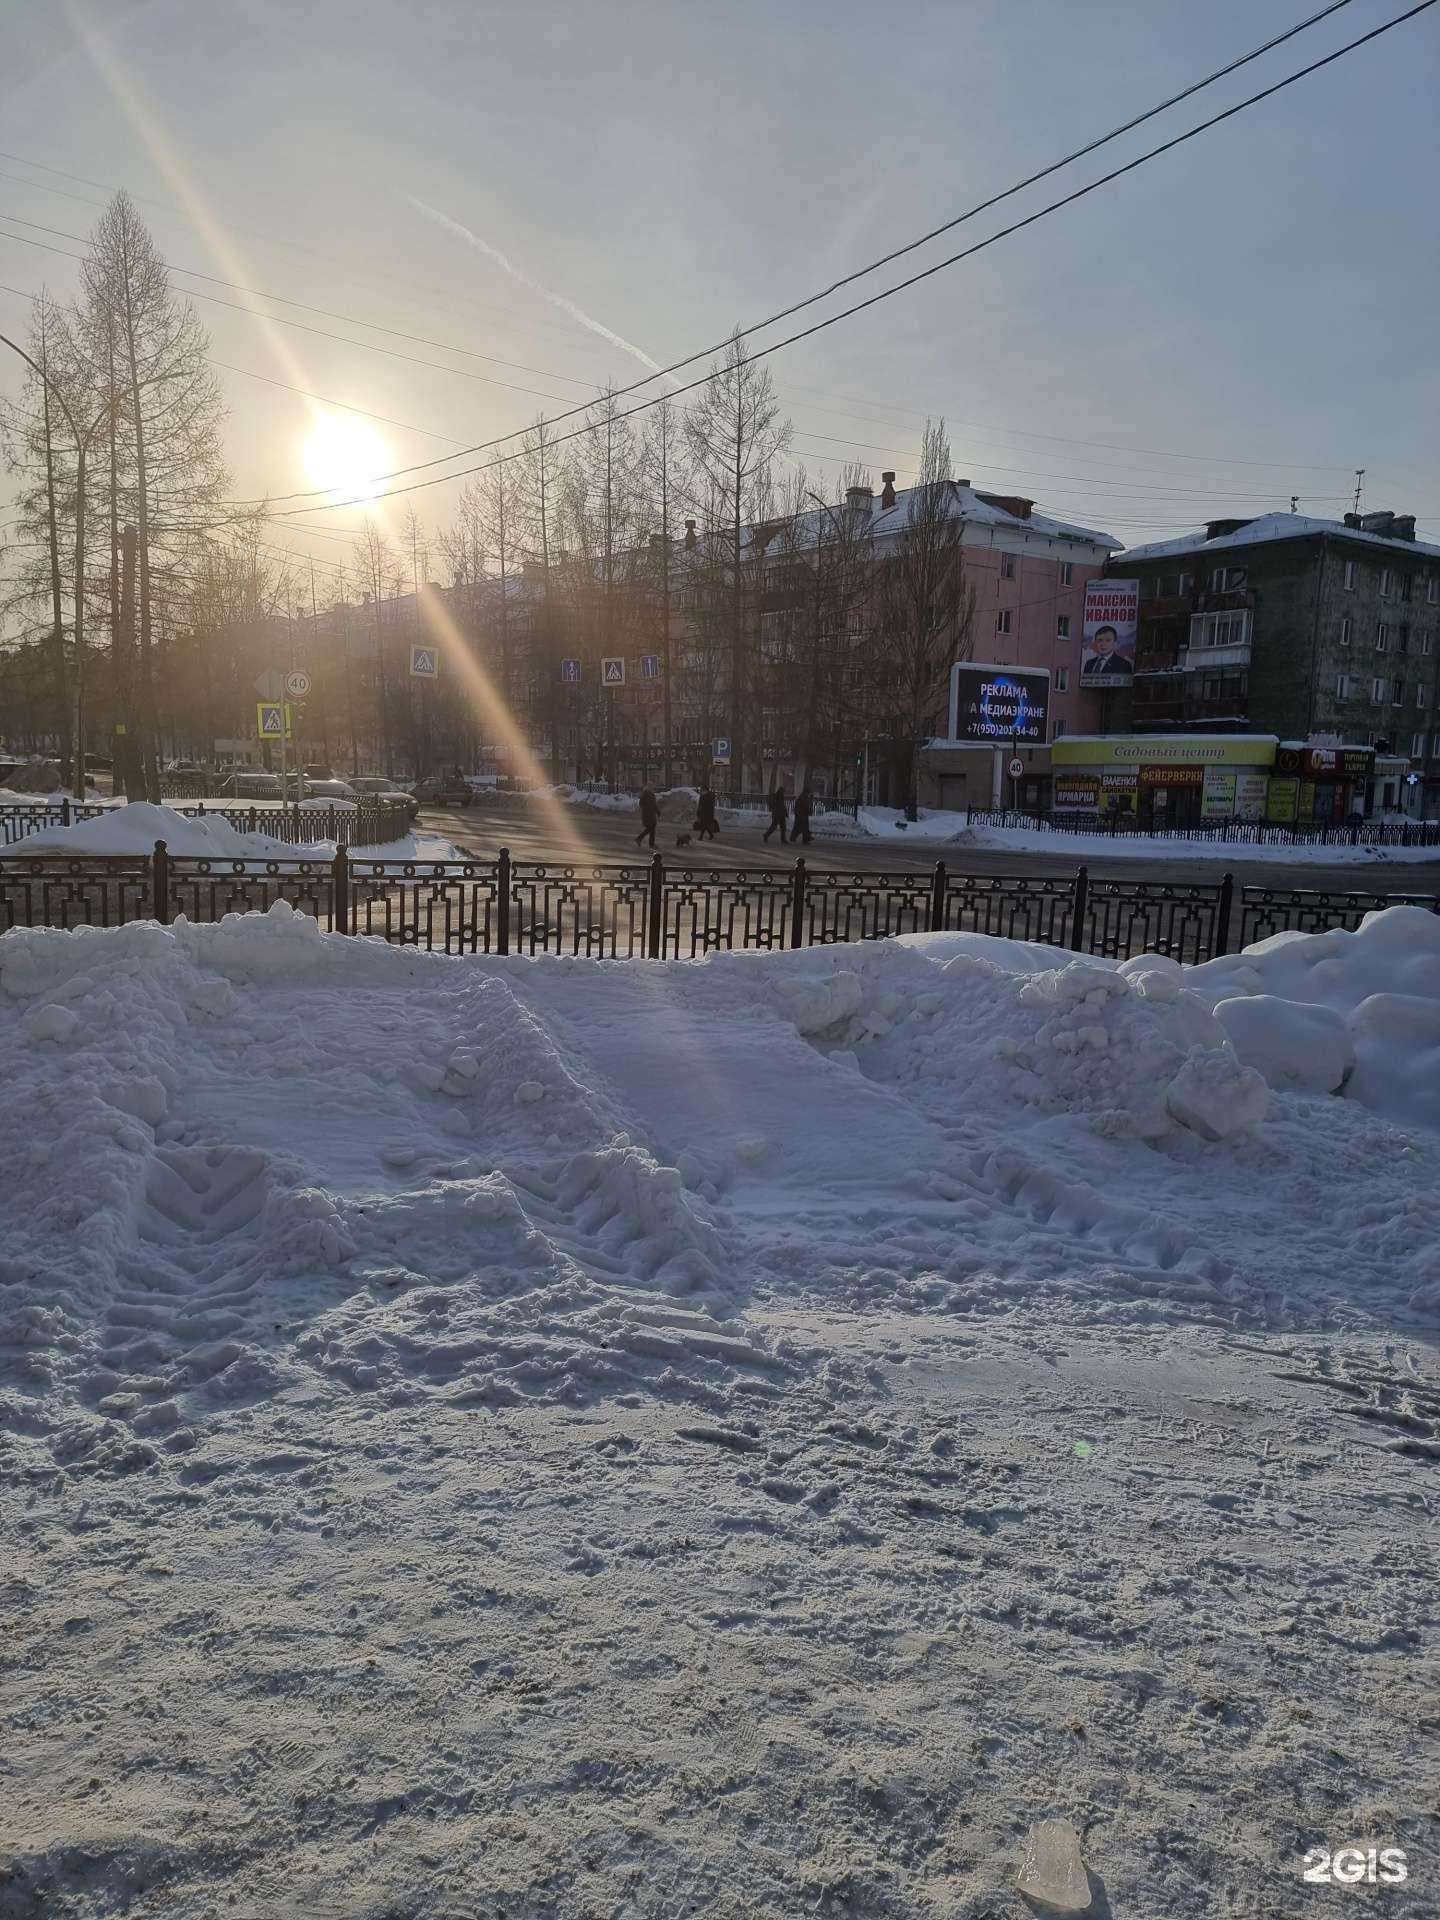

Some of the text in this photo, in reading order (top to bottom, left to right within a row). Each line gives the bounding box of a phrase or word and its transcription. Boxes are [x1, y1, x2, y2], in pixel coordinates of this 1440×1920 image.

[1087, 595, 1136, 607] МАКСИМ
[1086, 608, 1136, 622] ИВАНОВ
[290, 678, 306, 689] 40
[980, 683, 1028, 698] РЕКЛАМА
[979, 703, 1045, 718] МЕДИАЭКРАНЕ
[1113, 746, 1225, 760] Садовый центр
[1010, 762, 1021, 773] 40
[1102, 776, 1137, 786] ВАЛЕНКИ
[1141, 769, 1203, 782] ФЕЙЕРВЕРКИ
[1056, 791, 1095, 801] ЯРМАРКА
